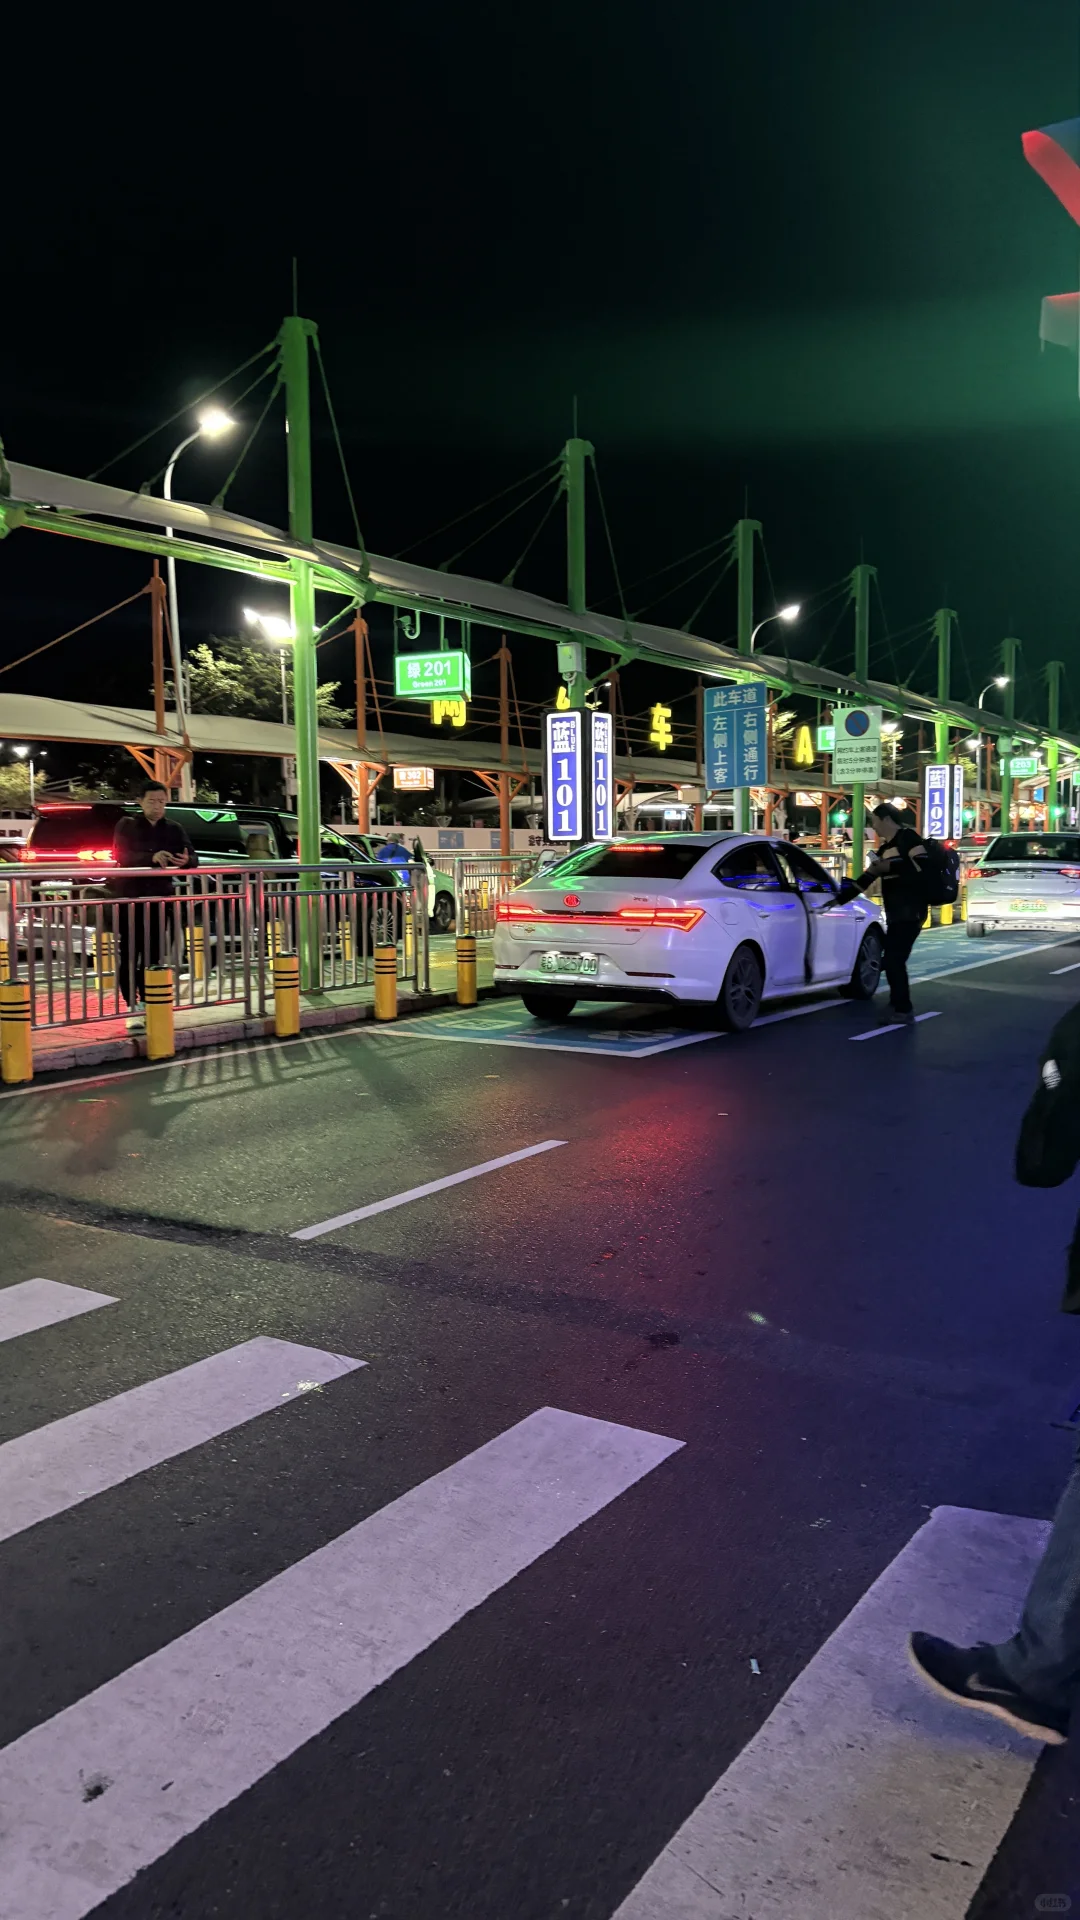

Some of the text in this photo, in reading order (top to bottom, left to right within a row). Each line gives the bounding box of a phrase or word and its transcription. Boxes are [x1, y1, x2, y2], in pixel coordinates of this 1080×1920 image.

[407, 660, 451, 679] 绿 201
[412, 679, 446, 689] Green 201
[713, 687, 757, 708] 此车道
[552, 721, 570, 753] 蓝
[650, 702, 673, 750] 车
[797, 725, 814, 763] A
[713, 716, 728, 784] 左侧上客
[743, 711, 758, 781] 右侧通行
[556, 757, 573, 832] 101
[596, 758, 607, 831] 101
[930, 791, 943, 835] 102
